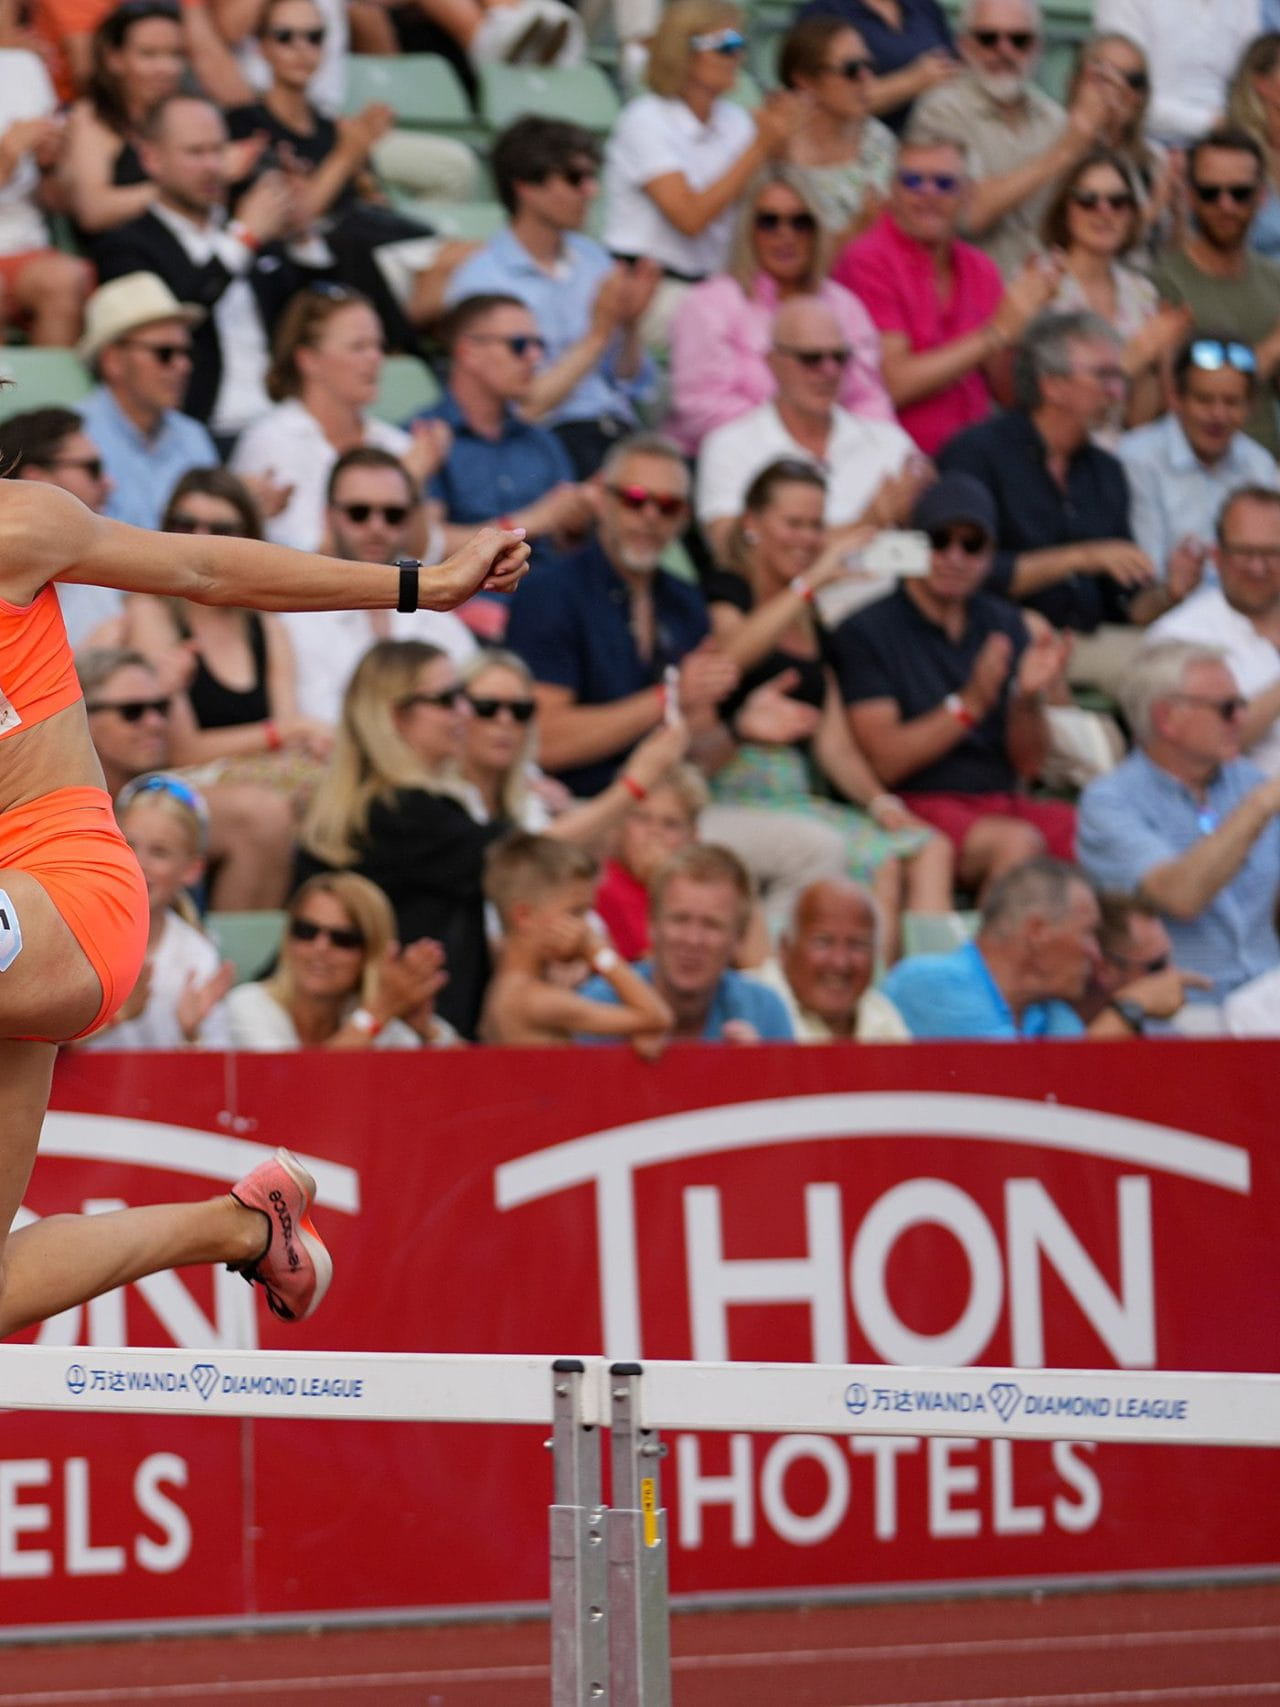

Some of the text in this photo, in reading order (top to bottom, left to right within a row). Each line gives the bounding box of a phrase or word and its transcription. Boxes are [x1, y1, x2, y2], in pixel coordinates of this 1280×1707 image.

[495, 1090, 1251, 1369] THON
[127, 1372, 189, 1393] WANDA
[222, 1375, 297, 1397] DIAMOND
[301, 1377, 364, 1398] LEAGUE
[916, 1391, 986, 1413] WANDA
[1024, 1395, 1110, 1417] DIAMOND
[1116, 1397, 1189, 1420] LEAGUE
[676, 1434, 1102, 1550] HOTELS
